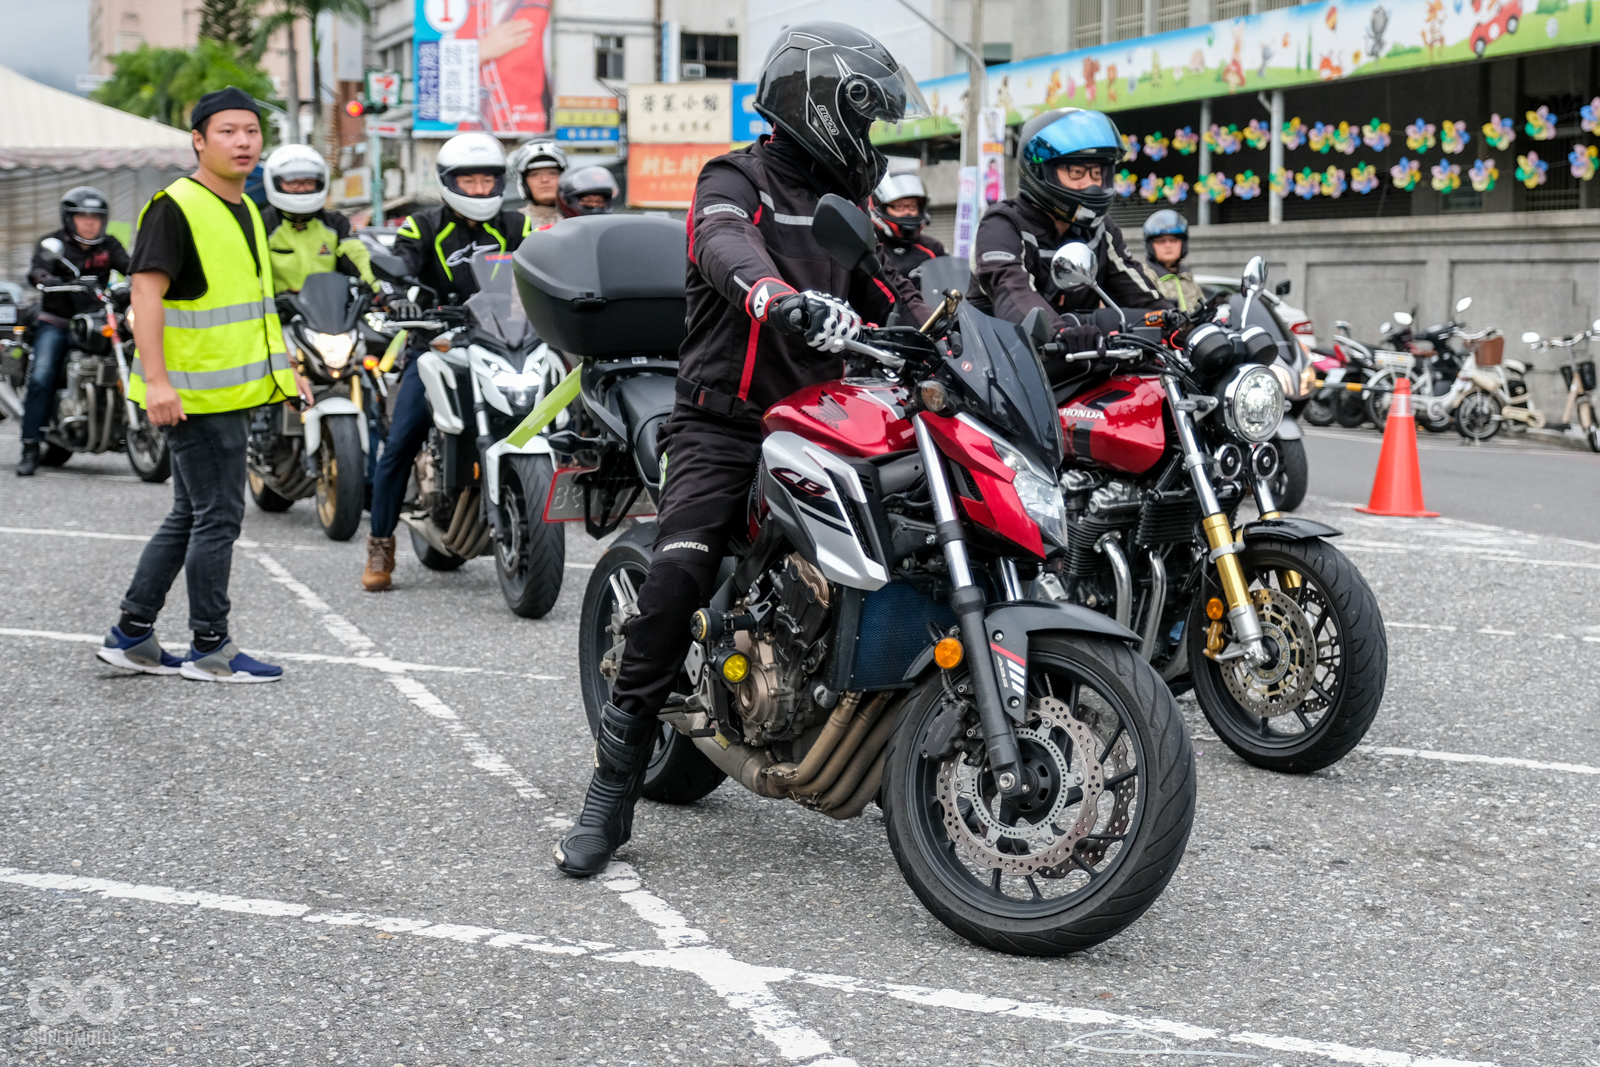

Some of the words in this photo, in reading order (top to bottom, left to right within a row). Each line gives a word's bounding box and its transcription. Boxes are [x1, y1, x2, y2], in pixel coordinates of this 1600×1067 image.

[797, 408, 839, 430] HONDA
[1062, 407, 1106, 420] HONDA
[769, 467, 832, 497] CB
[662, 541, 709, 553] BENKIA
[997, 655, 1009, 688] ABS
